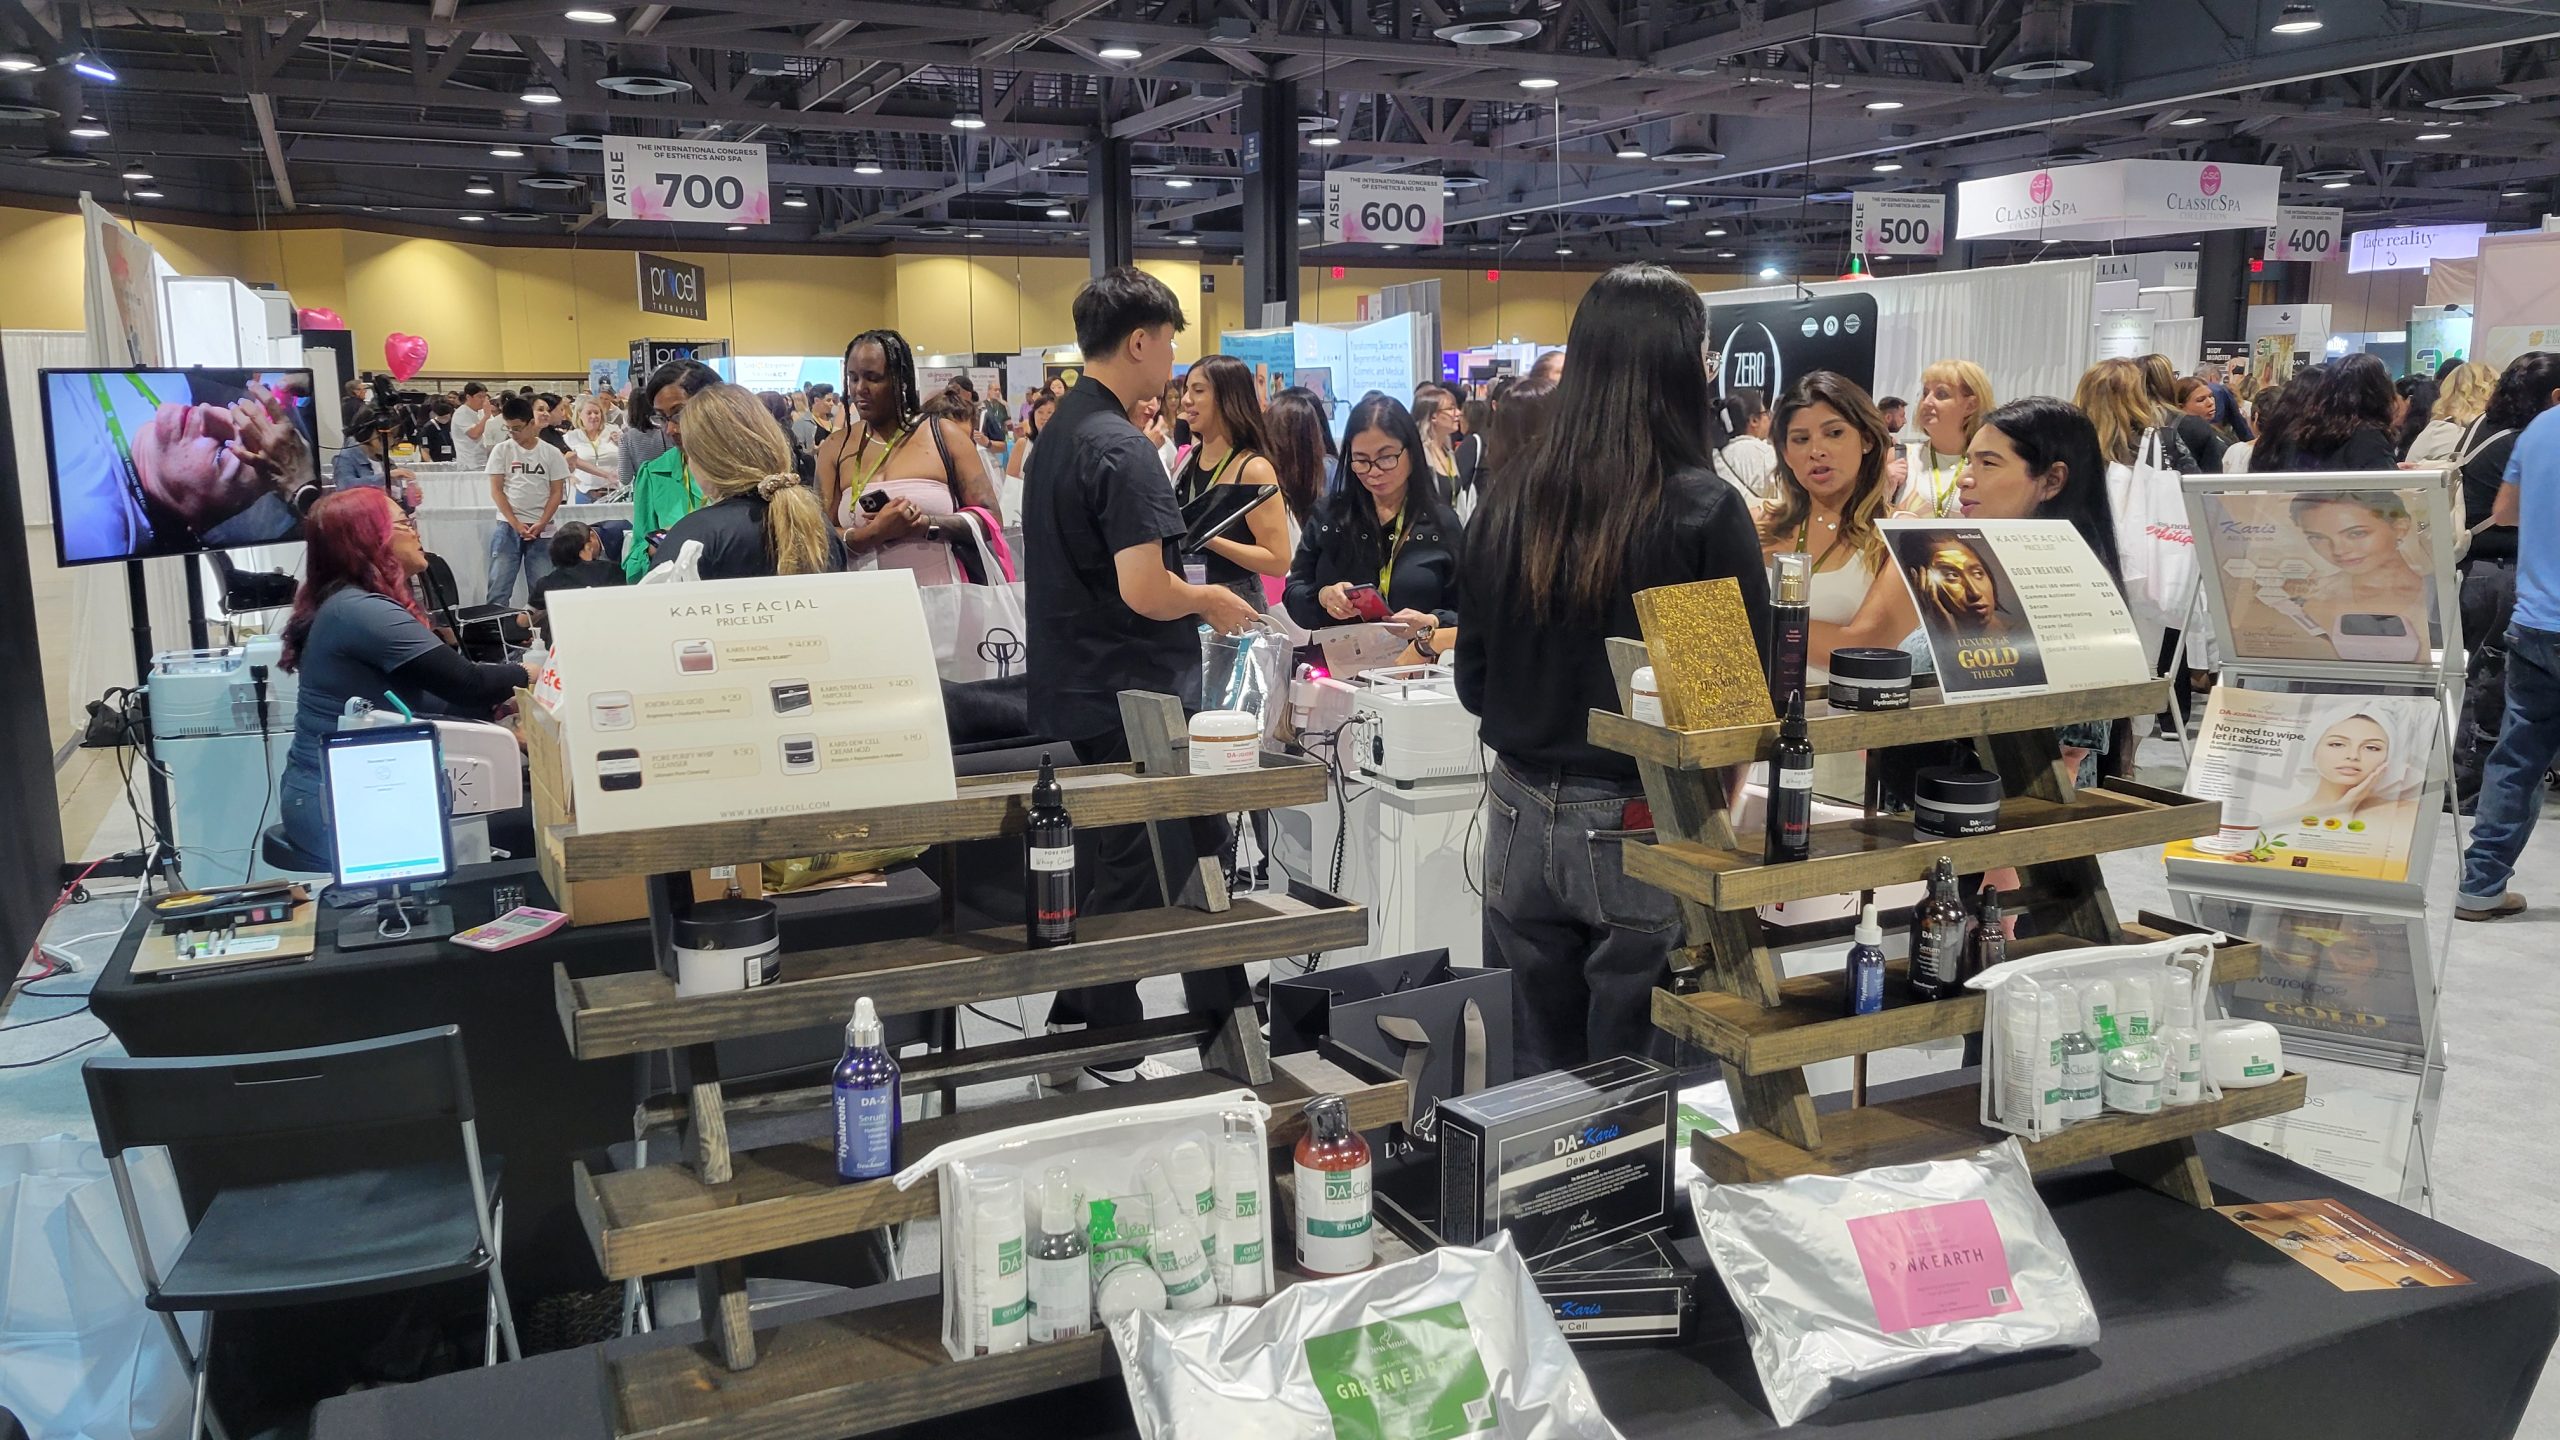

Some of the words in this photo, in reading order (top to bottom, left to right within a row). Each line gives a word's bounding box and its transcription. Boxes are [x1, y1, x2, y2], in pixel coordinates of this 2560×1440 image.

[653, 144, 716, 154] INTERNATIONAL
[717, 148, 758, 156] CONGRESS
[666, 152, 708, 160] ESTHETICS
[610, 151, 626, 206] AISLE
[1362, 177, 1406, 186] INTERNATIONAL
[655, 173, 744, 210] 700
[1329, 183, 1340, 230] AISLE
[1361, 201, 1426, 232] 600
[1855, 202, 1864, 243] AISLE
[1880, 218, 1929, 244] 500
[2288, 229, 2330, 252] 400
[2386, 230, 2435, 248] reality
[652, 302, 700, 316] THERAPIES
[1733, 351, 1765, 388] ZERO
[511, 460, 546, 474] FILA
[2219, 520, 2276, 534] Karis
[2010, 567, 2032, 576] GOLD
[2031, 566, 2074, 574] TREATMENT
[670, 602, 735, 618] KARIS
[742, 599, 819, 612] FACIAL
[716, 616, 750, 627] PRICE
[752, 614, 775, 625] LIST
[726, 645, 746, 654] KARIS
[746, 644, 770, 652] FACIAL
[1956, 636, 1993, 648] LUXURY
[1957, 646, 2020, 670] GOLD
[1970, 667, 2015, 680] THERAPY
[858, 682, 873, 690] CELL
[1873, 698, 1899, 706] Hydrating
[2212, 731, 2226, 740] let
[2228, 732, 2237, 742] it
[2238, 734, 2281, 746] absorb!
[2214, 723, 2231, 732] No
[2232, 726, 2262, 736] need
[2263, 729, 2274, 738] to
[2276, 731, 2306, 742] wipe,
[864, 738, 880, 746] CELL
[830, 747, 854, 756] CREAM
[2244, 748, 2268, 756] massage
[1921, 930, 1942, 941] DA-2
[1919, 943, 1940, 954] Serum
[2264, 1001, 2386, 1028] GOLD
[861, 1096, 887, 1107] DA-2
[858, 1114, 887, 1122] Serum
[836, 1095, 849, 1158] Hyaluronic
[1566, 1154, 1586, 1168] Dew
[1589, 1146, 1608, 1160] Cell
[1889, 1257, 1930, 1276] PNK
[1931, 1248, 1984, 1270] EARTH
[1567, 1321, 1588, 1332] Cell
[1336, 1371, 1396, 1400] GREEN
[1400, 1356, 1464, 1384] EARTH
